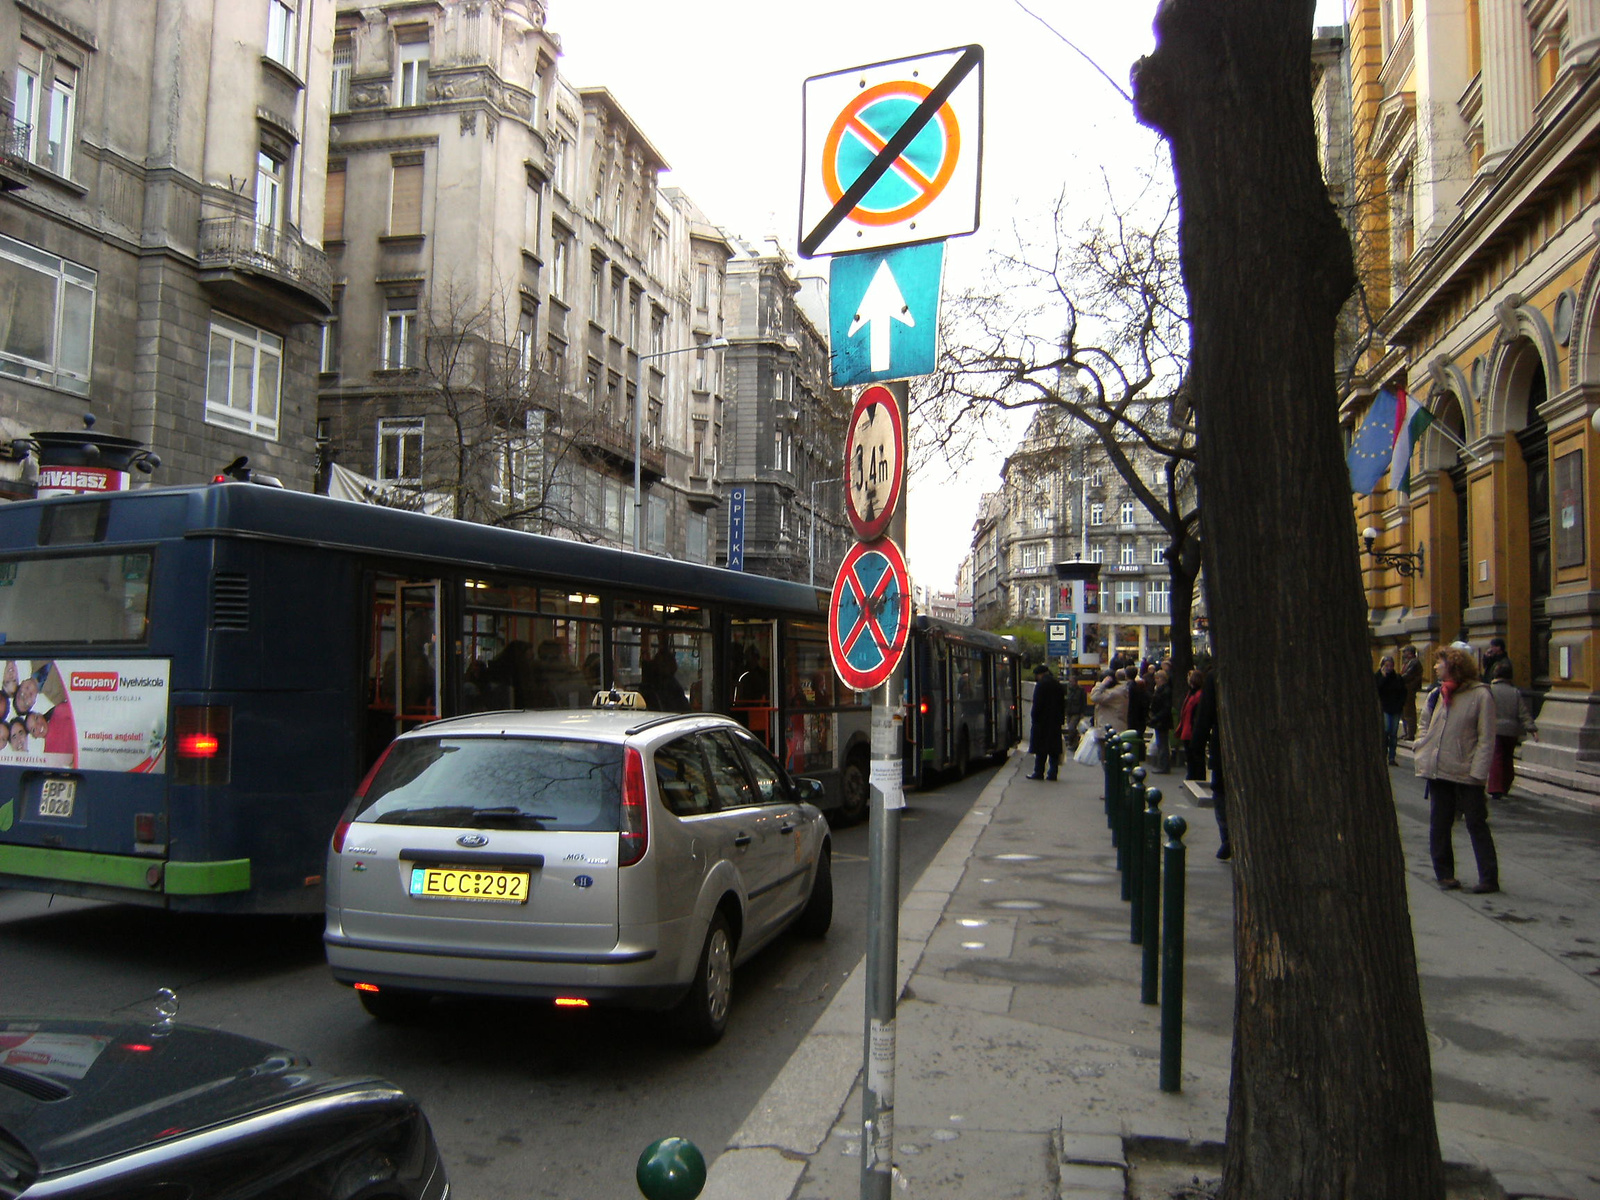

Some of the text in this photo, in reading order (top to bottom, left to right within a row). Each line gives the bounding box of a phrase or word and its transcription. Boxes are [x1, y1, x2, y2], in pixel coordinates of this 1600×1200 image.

[732, 491, 742, 565] OPTIKA
[72, 676, 164, 690] Company Nyelviskola
[463, 836, 480, 844] Ford
